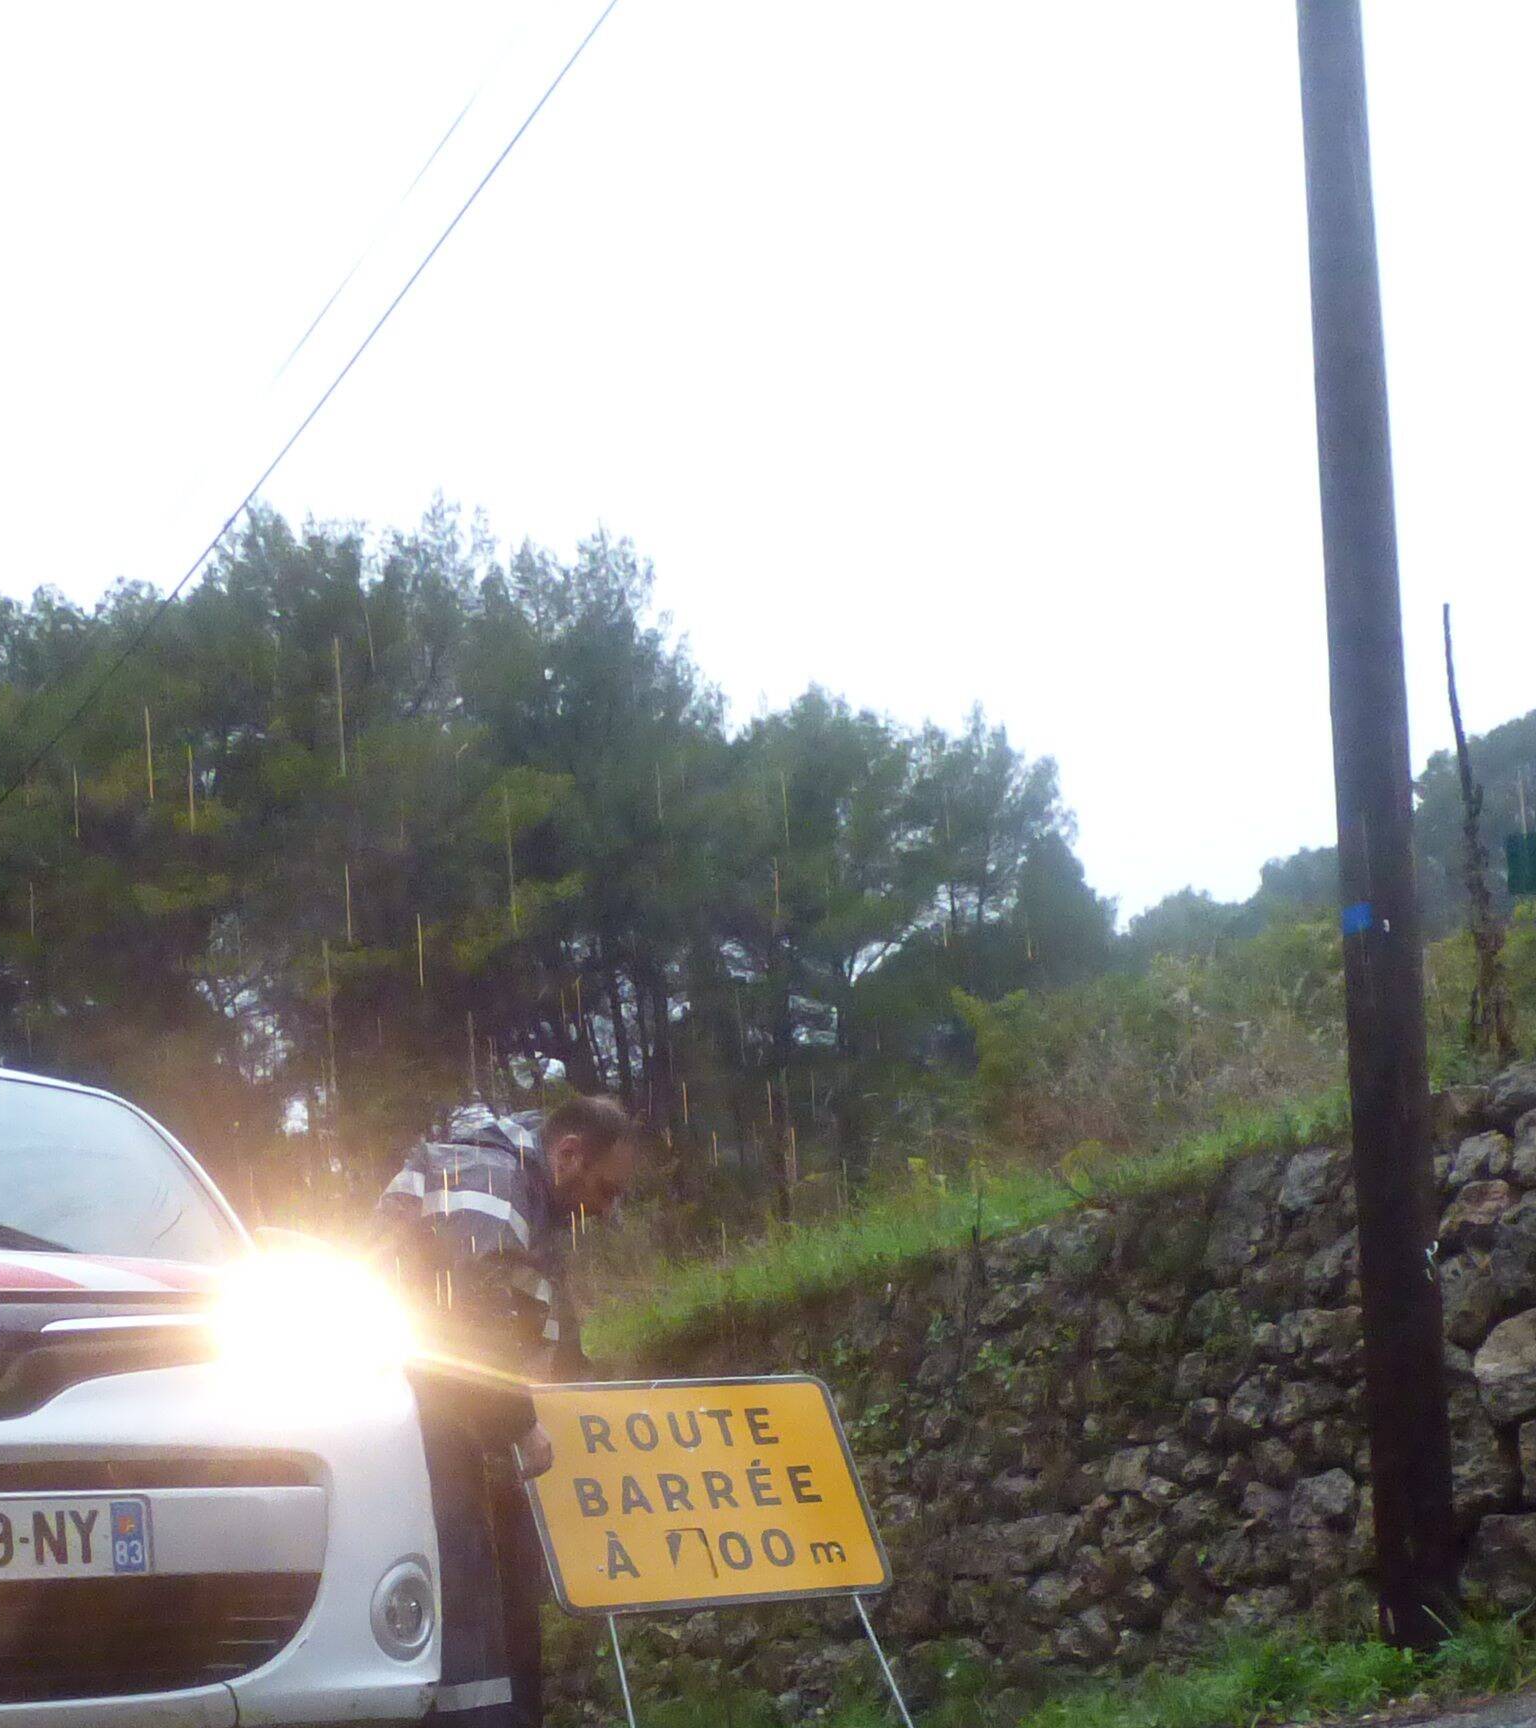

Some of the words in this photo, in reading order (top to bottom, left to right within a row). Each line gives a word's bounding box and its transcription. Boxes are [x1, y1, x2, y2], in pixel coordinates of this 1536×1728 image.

[579, 1407, 779, 1454] ROUTE
[573, 1459, 823, 1518] BARRÉE
[115, 1540, 144, 1565] 83
[665, 1530, 795, 1572] 00
